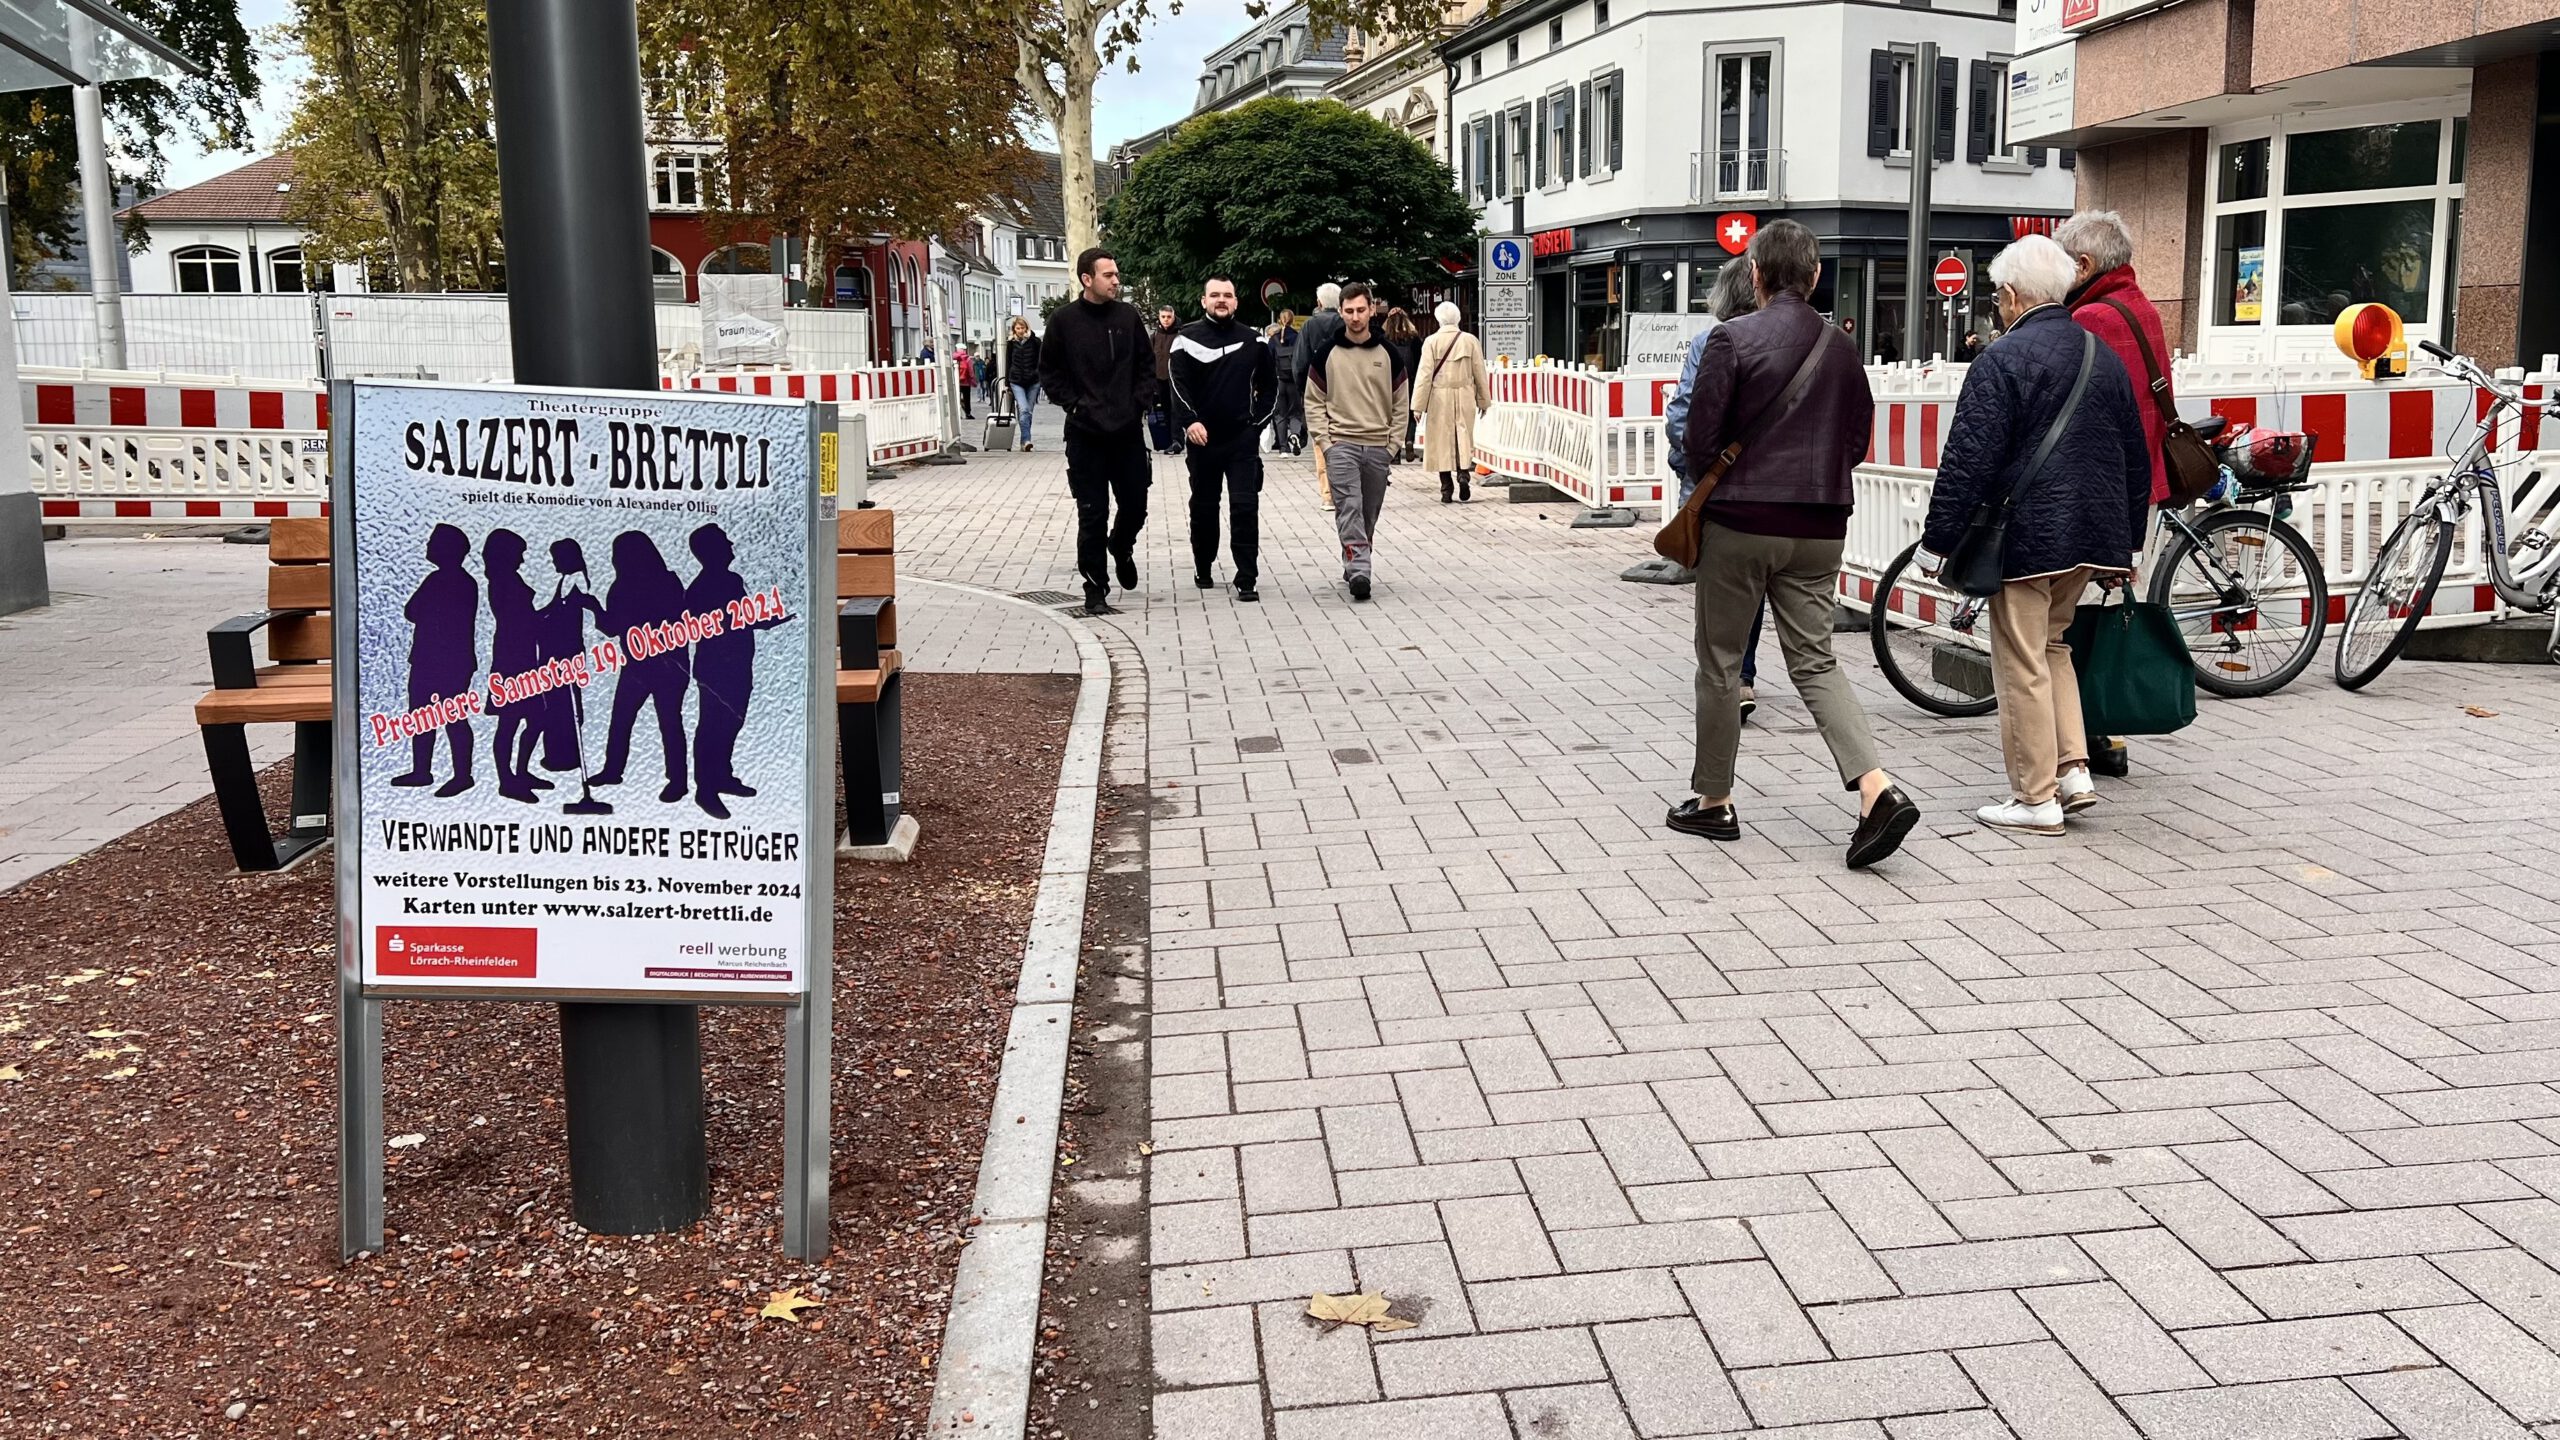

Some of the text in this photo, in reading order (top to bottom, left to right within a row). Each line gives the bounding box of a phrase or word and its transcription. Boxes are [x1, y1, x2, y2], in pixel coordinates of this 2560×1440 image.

[1495, 272, 1517, 280] ZONE
[527, 399, 662, 419] Theatergruppe
[405, 418, 579, 487] SALZERT
[608, 421, 771, 491] BRETTLI
[462, 491, 718, 515] spielt die Komödie von Alexander Ollig
[2490, 490, 2506, 555] PEGASUS
[369, 586, 784, 748] Premiere Samstag 19. Oktober 2024
[382, 819, 799, 862] VERWANDTE UND ANDERE BETRÜGER
[373, 871, 801, 899] weitere Vorstellungen bis 23. November 2024
[403, 896, 773, 923] Karten unter www.salzert-brettli.de
[410, 942, 465, 954] Sparkasse
[679, 942, 787, 960] reell werbung
[410, 956, 518, 967] Lörrach-Rheinfelden
